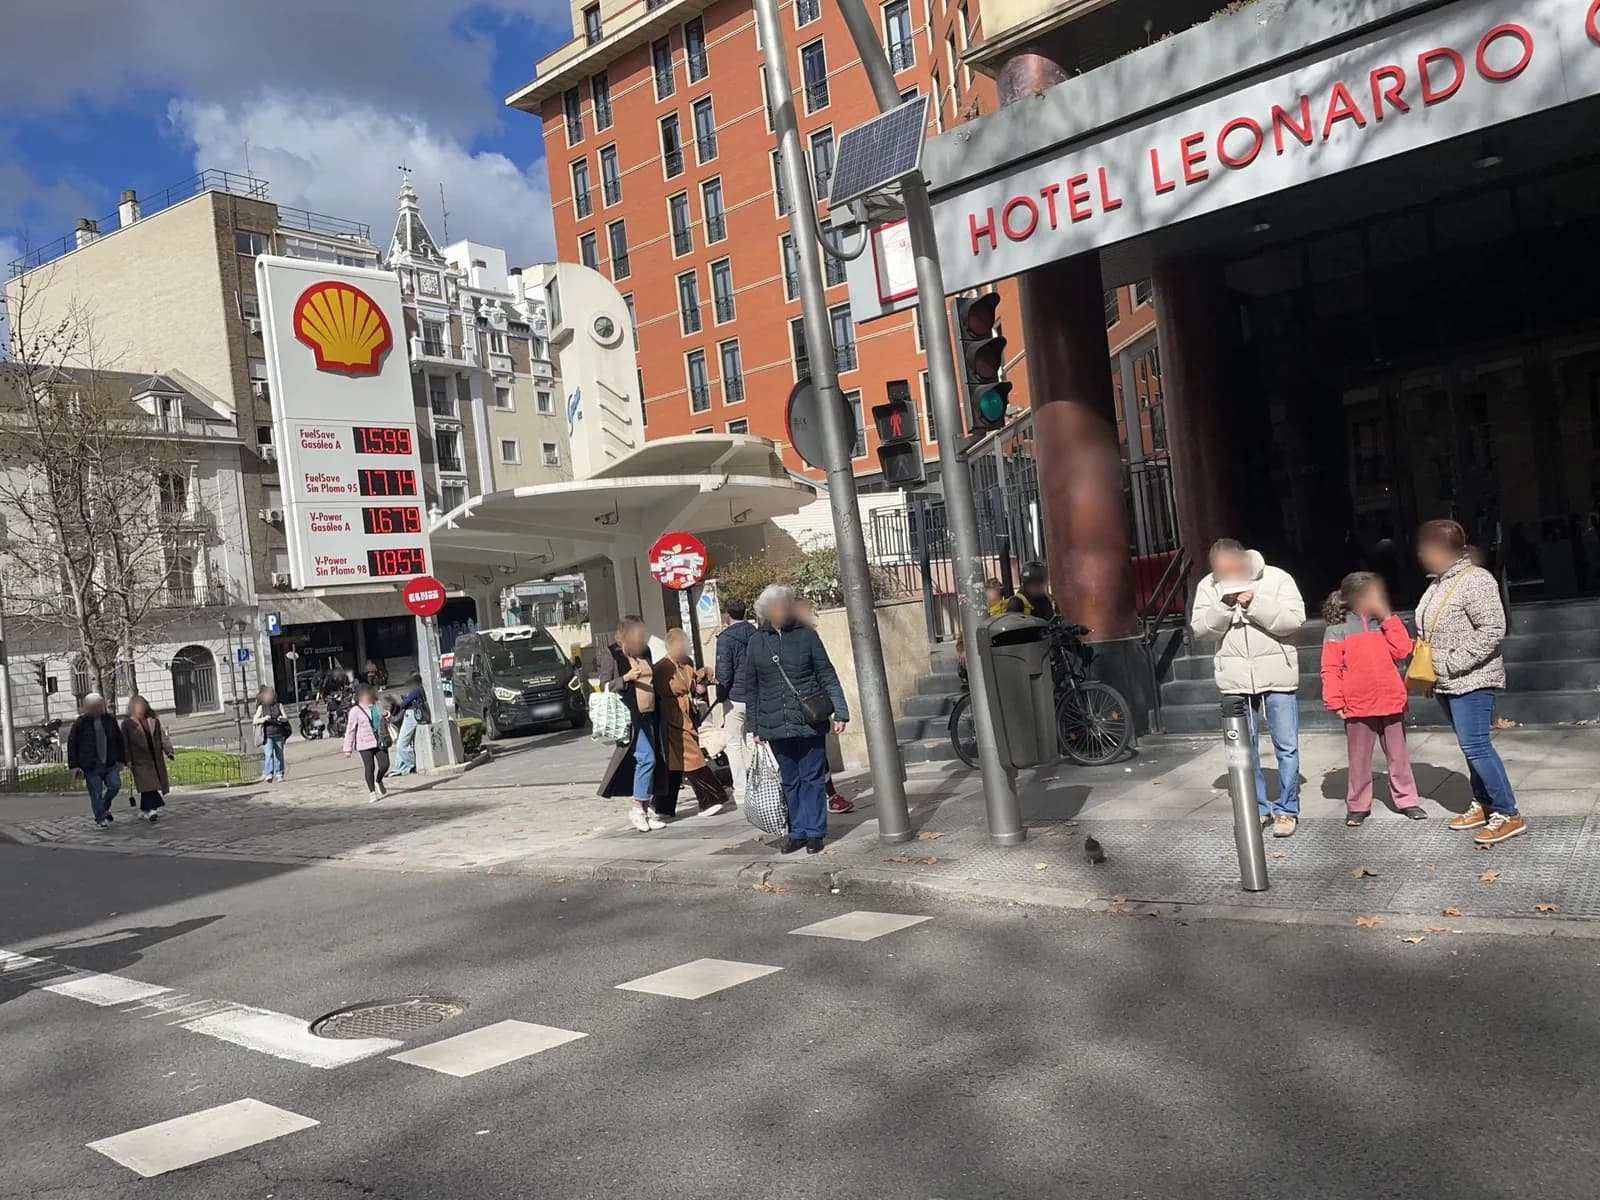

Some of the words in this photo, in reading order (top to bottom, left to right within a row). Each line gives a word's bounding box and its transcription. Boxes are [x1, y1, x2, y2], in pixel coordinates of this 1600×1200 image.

[968, 167, 1123, 256] HOTEL
[1150, 23, 1534, 195] LEONARDO
[300, 429, 335, 439] FuelSave
[301, 440, 333, 450] Gasóleo
[336, 440, 342, 449] A
[360, 428, 412, 454] 1.599
[305, 473, 340, 483] FuelSave
[365, 470, 418, 496] 1.714
[306, 484, 319, 493] Sin
[321, 484, 345, 493] Plomo
[347, 483, 358, 493] 95
[310, 512, 342, 521] V-Power
[369, 508, 421, 533] 1.679
[311, 522, 342, 532] Gasóleo
[345, 522, 351, 531] A
[315, 556, 347, 565] V-Power
[374, 549, 426, 576] 1.854
[316, 567, 329, 576] Sin
[331, 565, 355, 576] Plomo
[357, 565, 367, 574] 98
[268, 615, 276, 630] P
